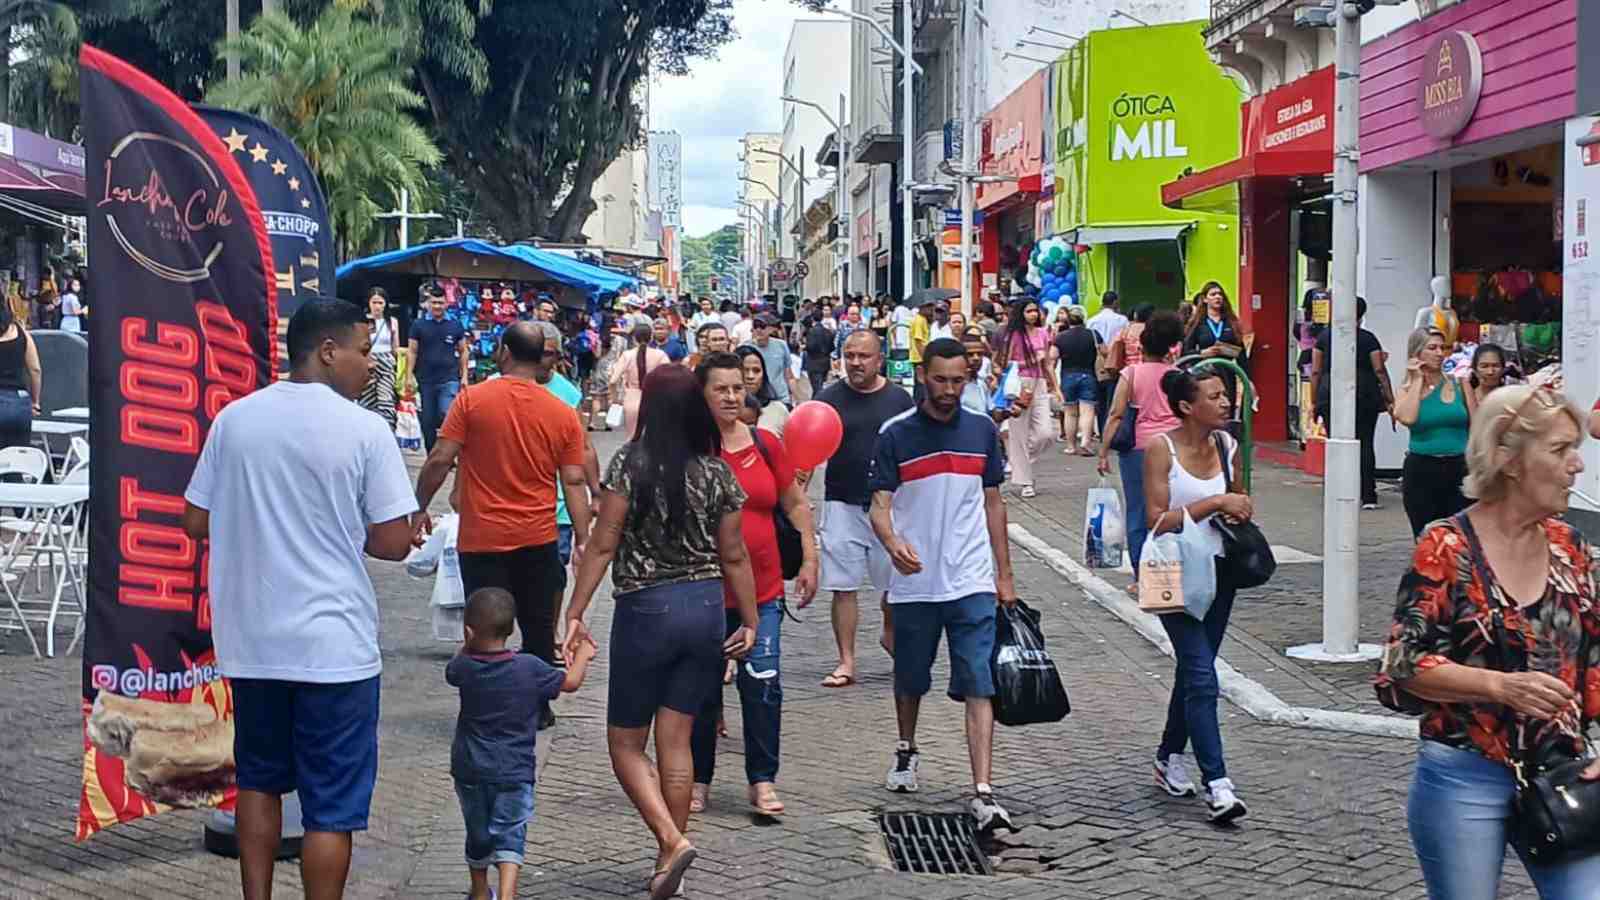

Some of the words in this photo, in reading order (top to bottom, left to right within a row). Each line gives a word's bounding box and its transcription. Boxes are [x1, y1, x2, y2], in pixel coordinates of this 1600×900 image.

[1113, 93, 1175, 117] ÓTICA
[1424, 80, 1446, 109] MISS
[1111, 120, 1188, 161] MIL
[120, 316, 199, 454] DOG
[118, 476, 196, 612] HOT
